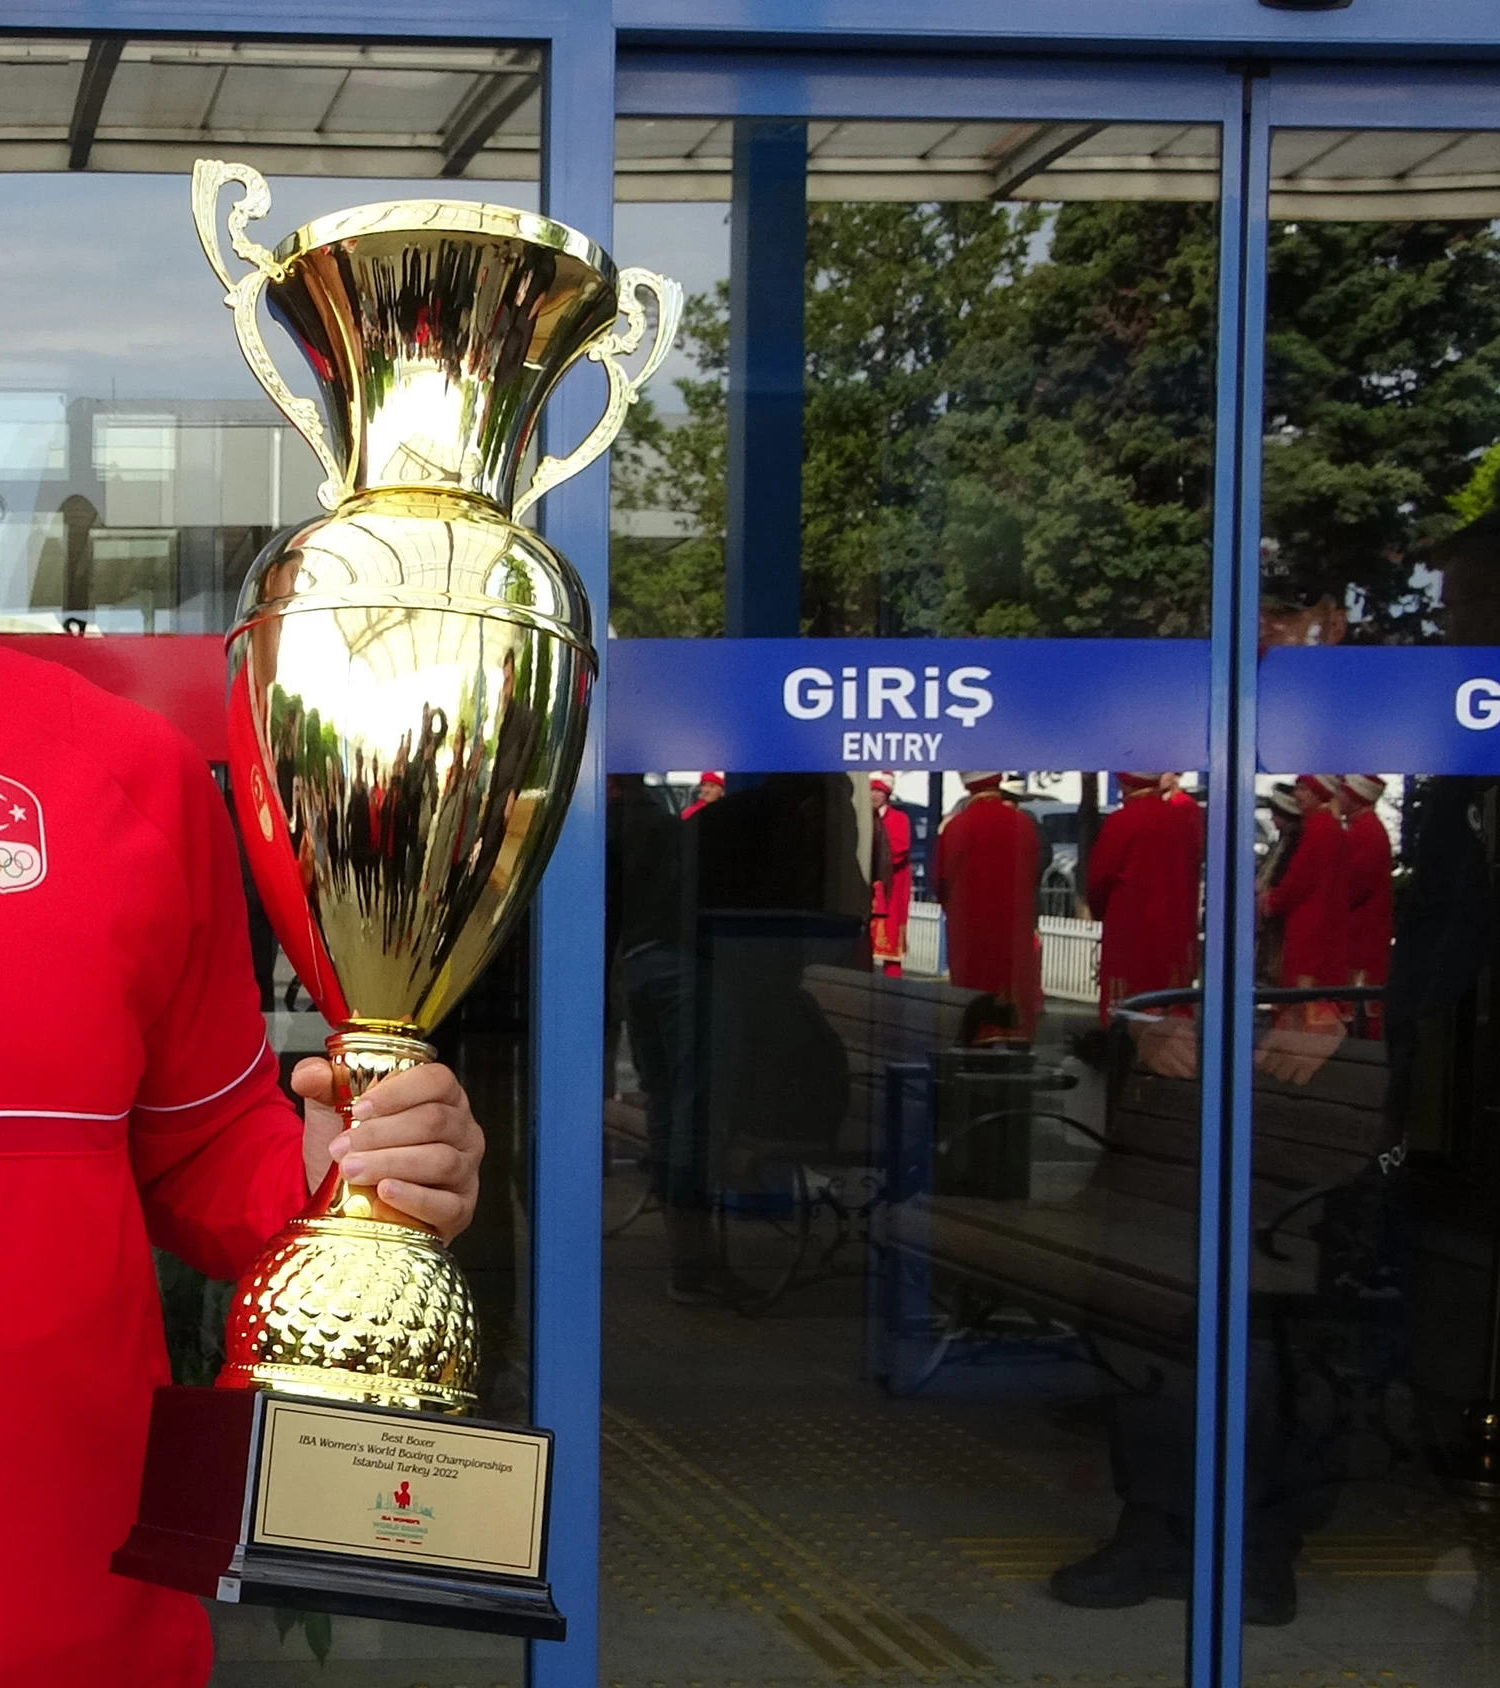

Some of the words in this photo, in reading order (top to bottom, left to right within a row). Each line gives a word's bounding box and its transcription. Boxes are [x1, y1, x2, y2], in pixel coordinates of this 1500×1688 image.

[842, 732, 943, 762] ENTRY
[381, 1432, 404, 1444] Best
[405, 1435, 436, 1448] Boxer
[298, 1435, 317, 1446] IBA
[319, 1438, 364, 1453] Women's
[367, 1444, 397, 1457] World
[398, 1448, 434, 1465] Boxing
[436, 1453, 513, 1474] Championships
[352, 1456, 395, 1471] Istanbul
[396, 1461, 431, 1478] Turkey
[432, 1467, 460, 1479] 2022
